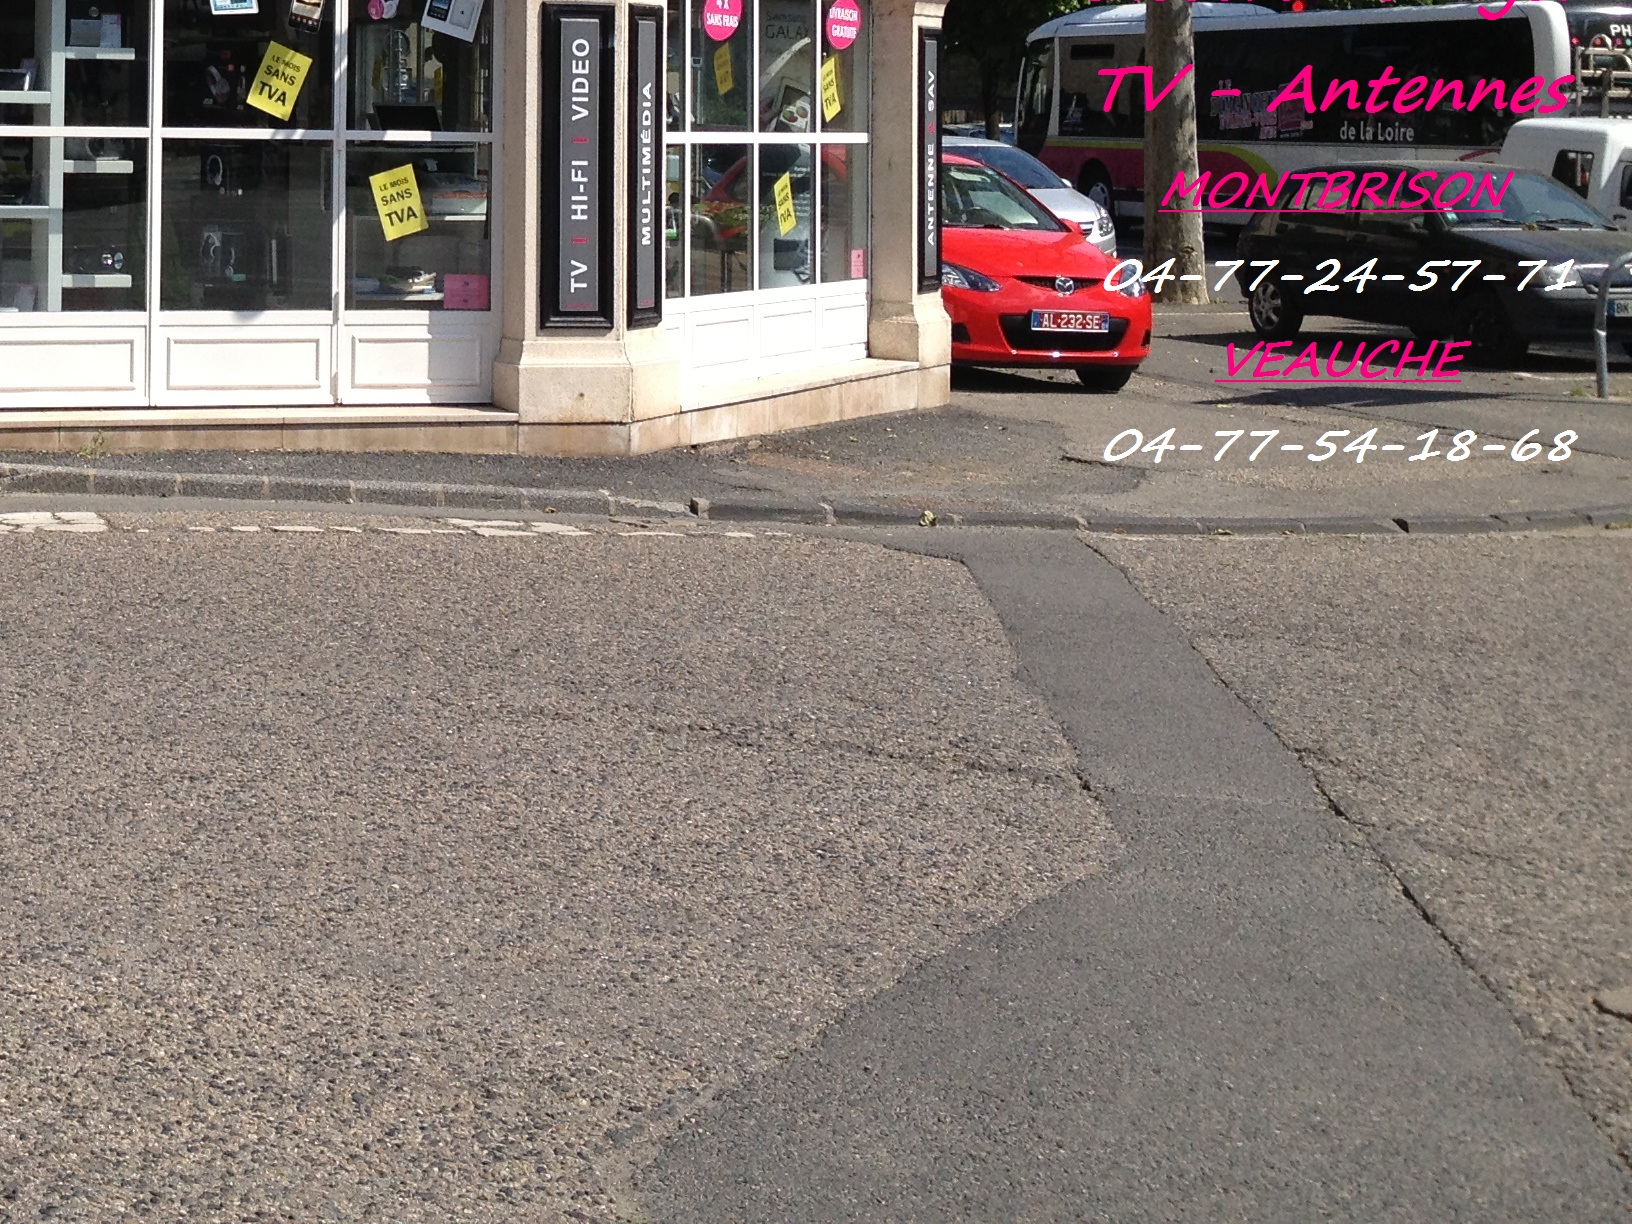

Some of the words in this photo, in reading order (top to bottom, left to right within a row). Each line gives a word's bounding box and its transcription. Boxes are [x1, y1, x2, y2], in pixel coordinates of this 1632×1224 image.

[706, 12, 723, 26] SANS
[722, 14, 739, 28] FRAIS
[263, 65, 298, 87] SANS
[571, 38, 590, 122] VIDEO
[257, 80, 289, 107] TVA
[824, 94, 837, 111] TVA
[927, 70, 935, 112] SAV
[1339, 121, 1356, 140] de
[1360, 121, 1373, 141] la
[1377, 122, 1415, 143] Loire
[641, 82, 653, 246] MULTIMÉDIA
[379, 183, 389, 192] LE
[389, 177, 410, 188] MOIS
[571, 159, 589, 221] HI-FI
[927, 143, 935, 246] ANTENNE
[380, 188, 413, 207] SANS
[384, 205, 419, 227] TVA
[570, 260, 588, 293] TV
